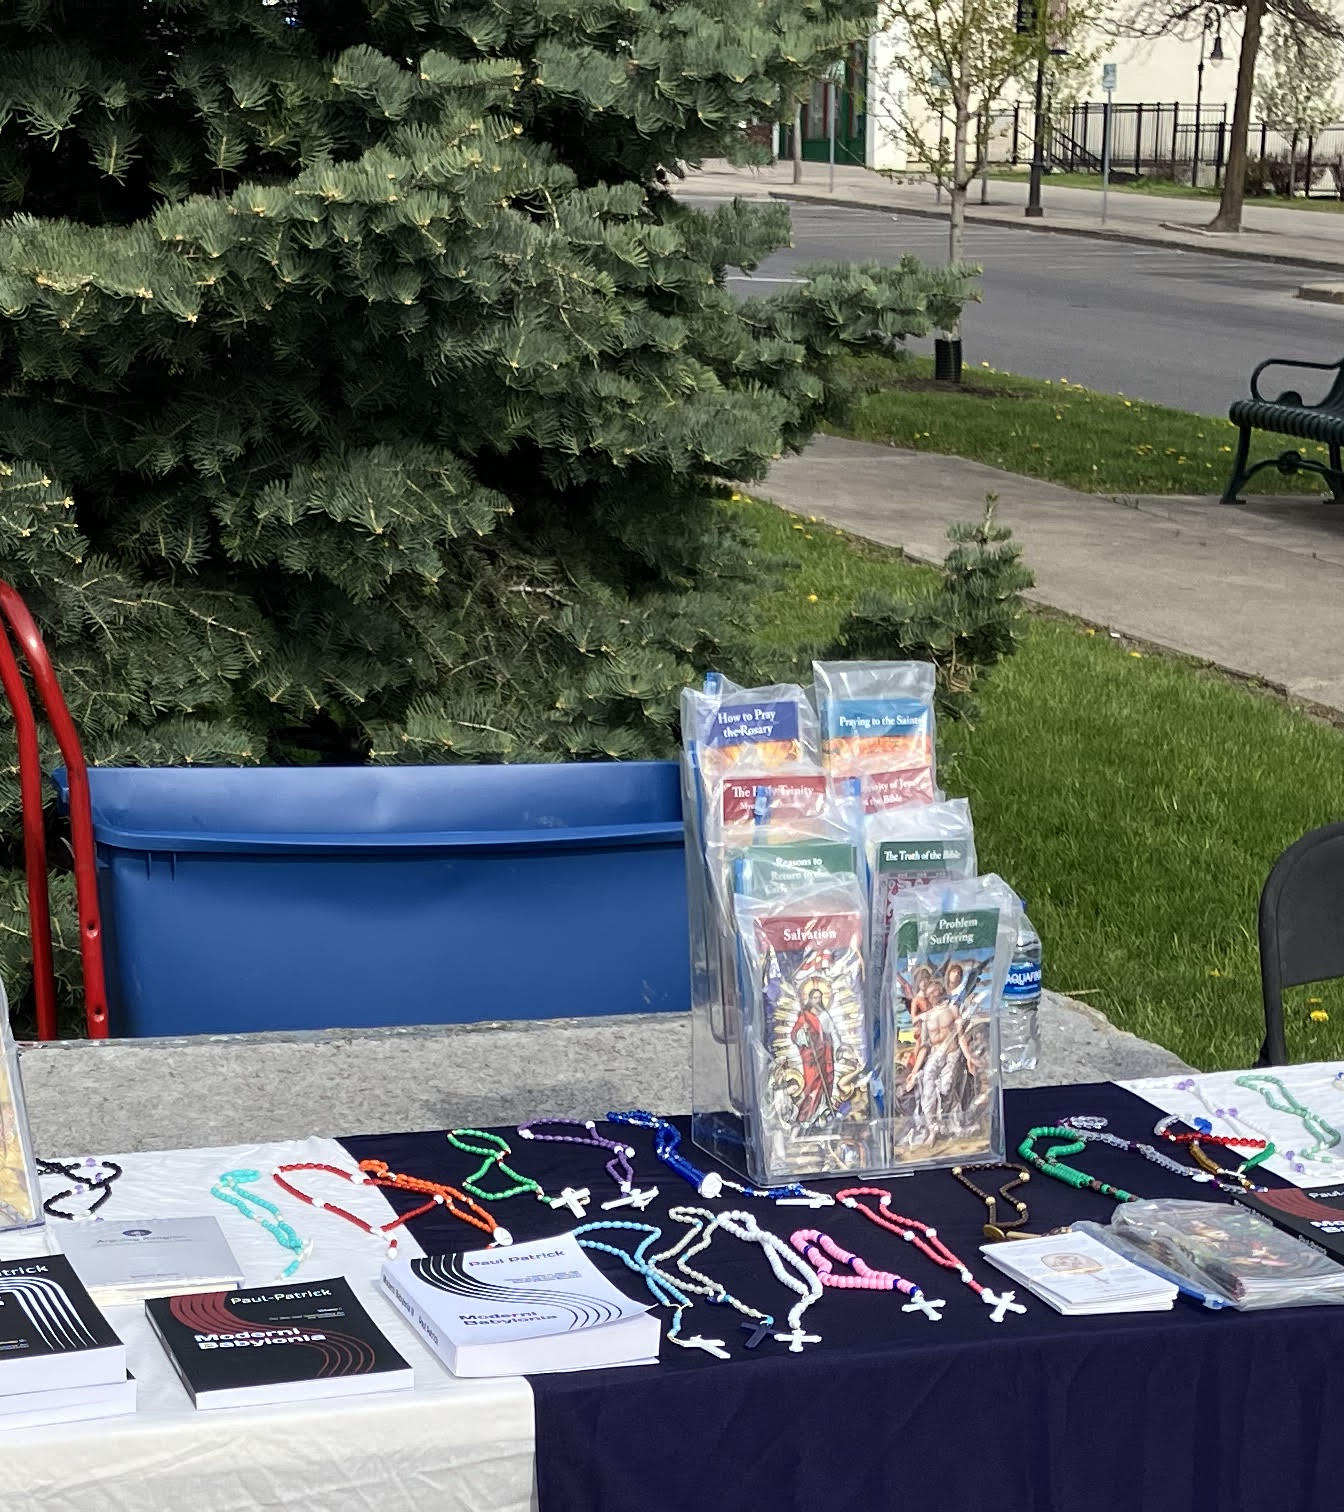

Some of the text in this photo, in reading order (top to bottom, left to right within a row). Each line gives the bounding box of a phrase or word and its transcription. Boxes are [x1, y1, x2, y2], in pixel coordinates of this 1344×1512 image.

[718, 708, 776, 725] How to Pray
[839, 716, 871, 728] Praying
[872, 717, 880, 726] to
[881, 716, 895, 726] the
[740, 724, 774, 736] Rosary
[732, 785, 751, 798] The
[777, 784, 814, 797] Trinity
[775, 856, 823, 867] Reasons to
[884, 850, 899, 861] The
[899, 849, 920, 861] Truth
[921, 849, 930, 860] of
[929, 850, 942, 860] the
[939, 916, 978, 931] Problem
[783, 927, 837, 942] Salvation
[929, 931, 974, 945] Suffering
[468, 1249, 566, 1267] Paul Patrick
[230, 1287, 333, 1306] Paul-Patrick
[458, 1310, 538, 1321] Moderni
[463, 1314, 559, 1326] Babylonia
[193, 1327, 302, 1343] Moderni
[198, 1333, 328, 1351] Babylonia
